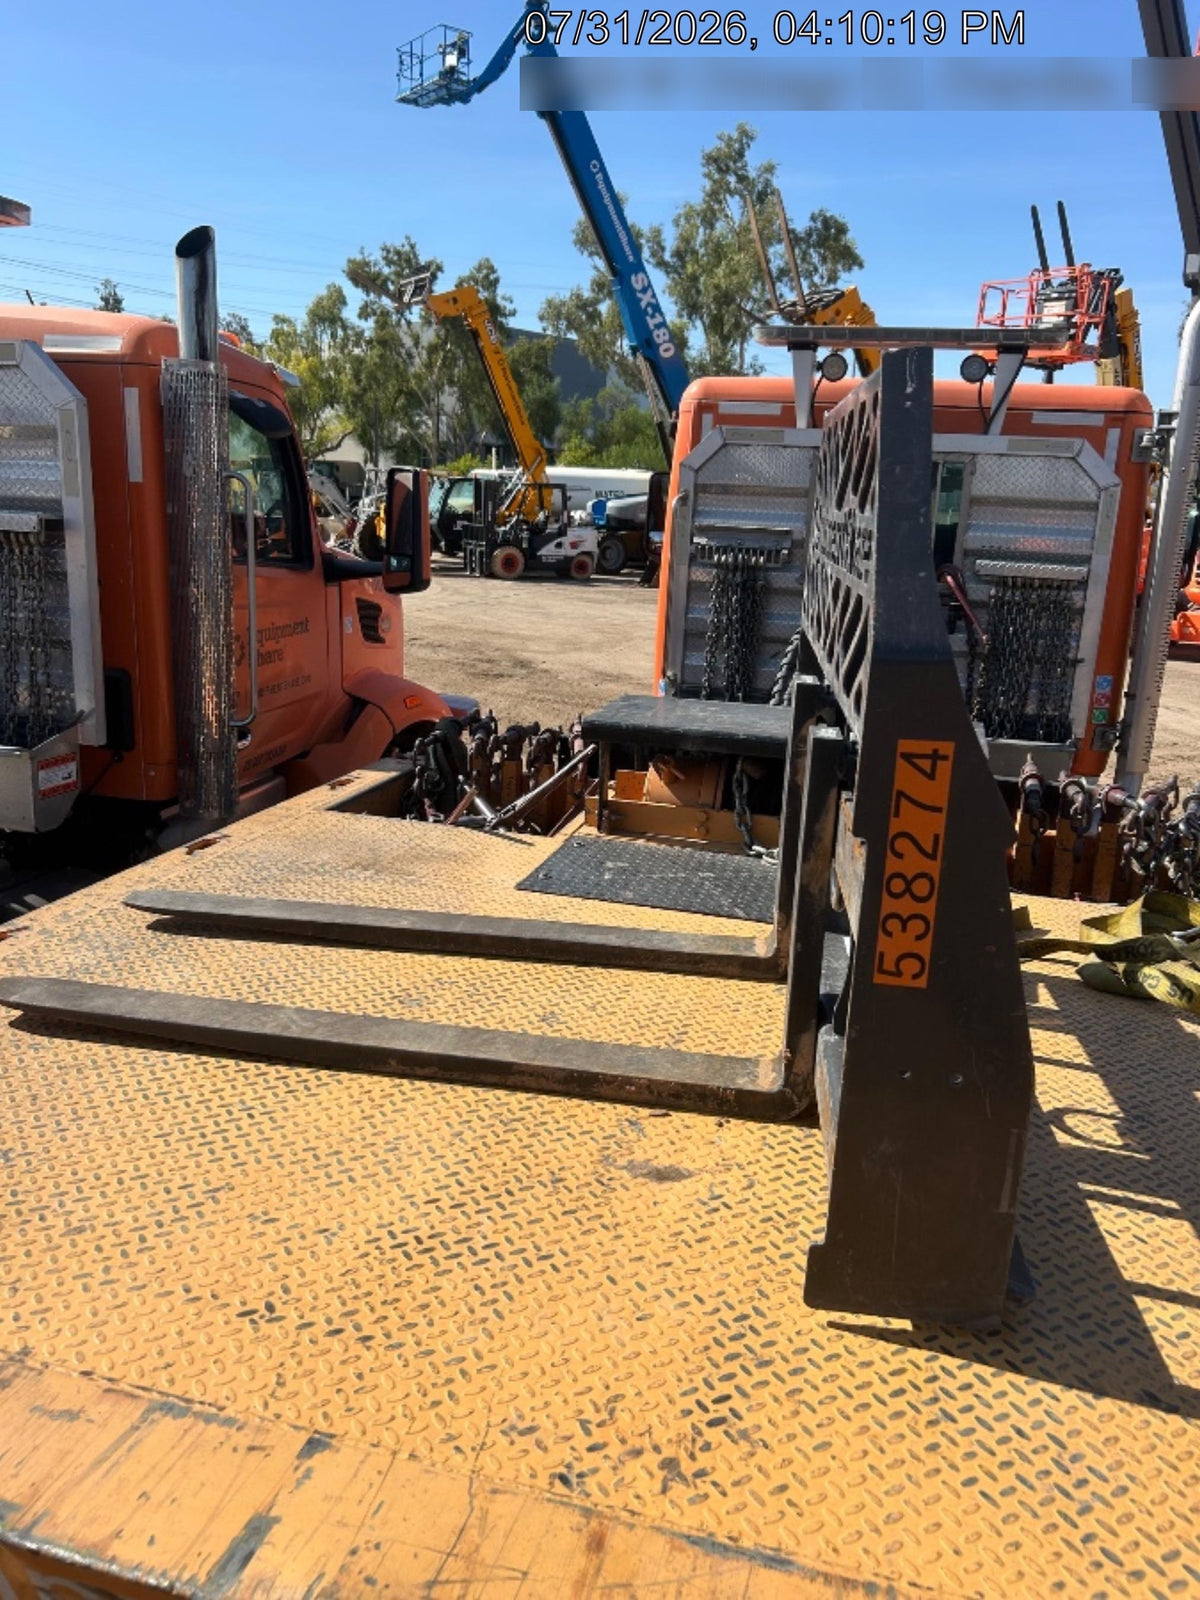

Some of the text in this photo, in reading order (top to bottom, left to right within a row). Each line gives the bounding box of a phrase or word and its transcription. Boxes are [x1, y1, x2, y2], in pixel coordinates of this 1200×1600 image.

[630, 271, 676, 359] SX-180
[256, 616, 310, 647] quipment
[877, 747, 950, 981] 538274
